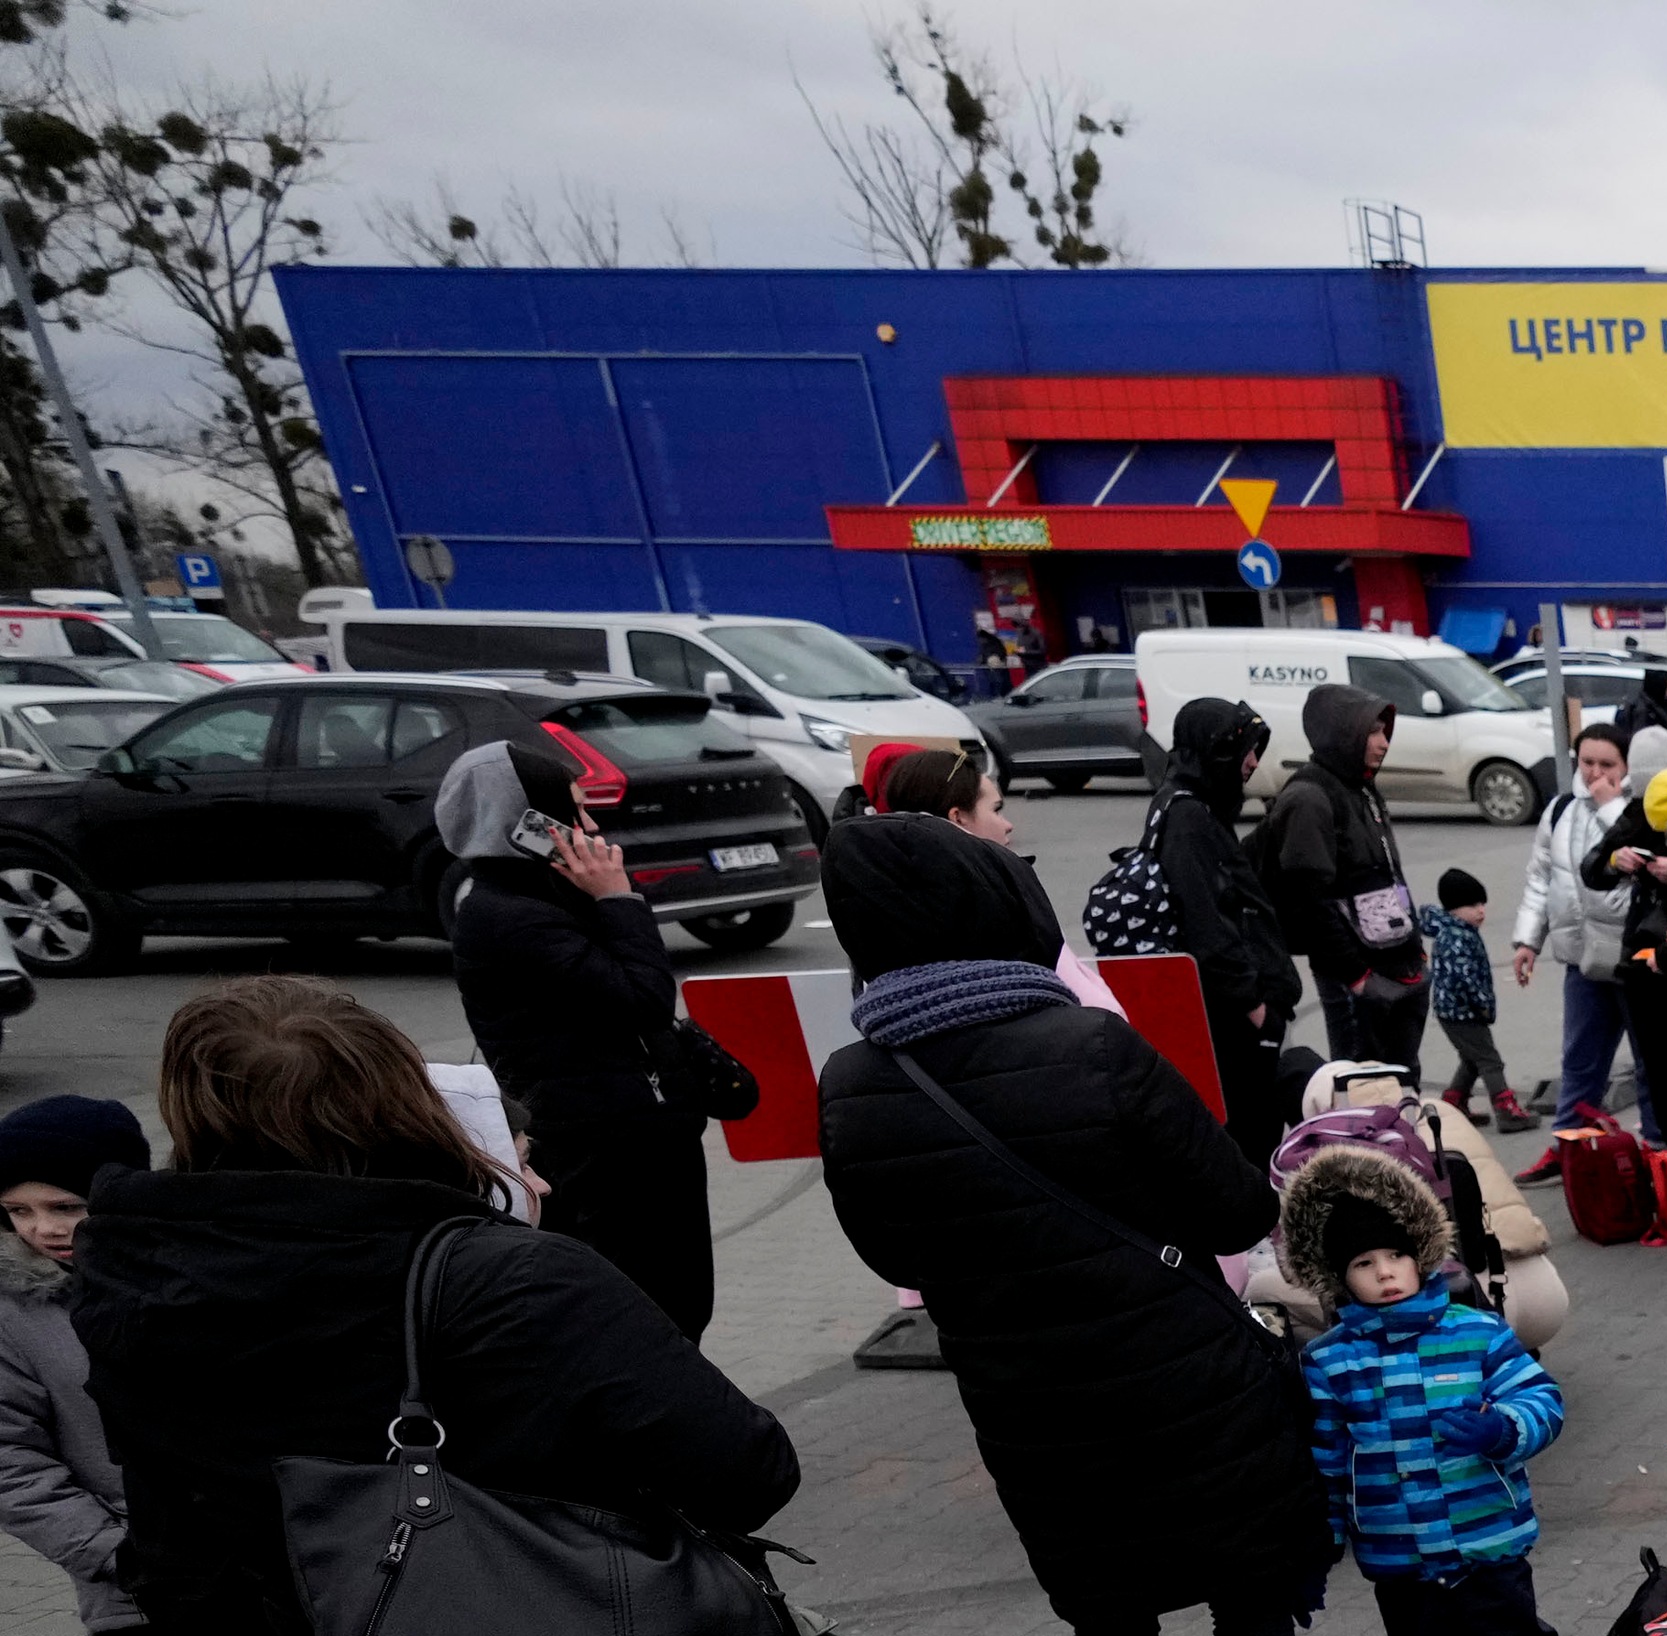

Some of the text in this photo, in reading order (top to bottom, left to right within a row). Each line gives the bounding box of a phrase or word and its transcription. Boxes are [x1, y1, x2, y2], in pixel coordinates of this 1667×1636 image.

[1510, 318, 1646, 361] ЦЕНТР
[184, 557, 210, 584] P
[1248, 665, 1329, 682] KASYNO
